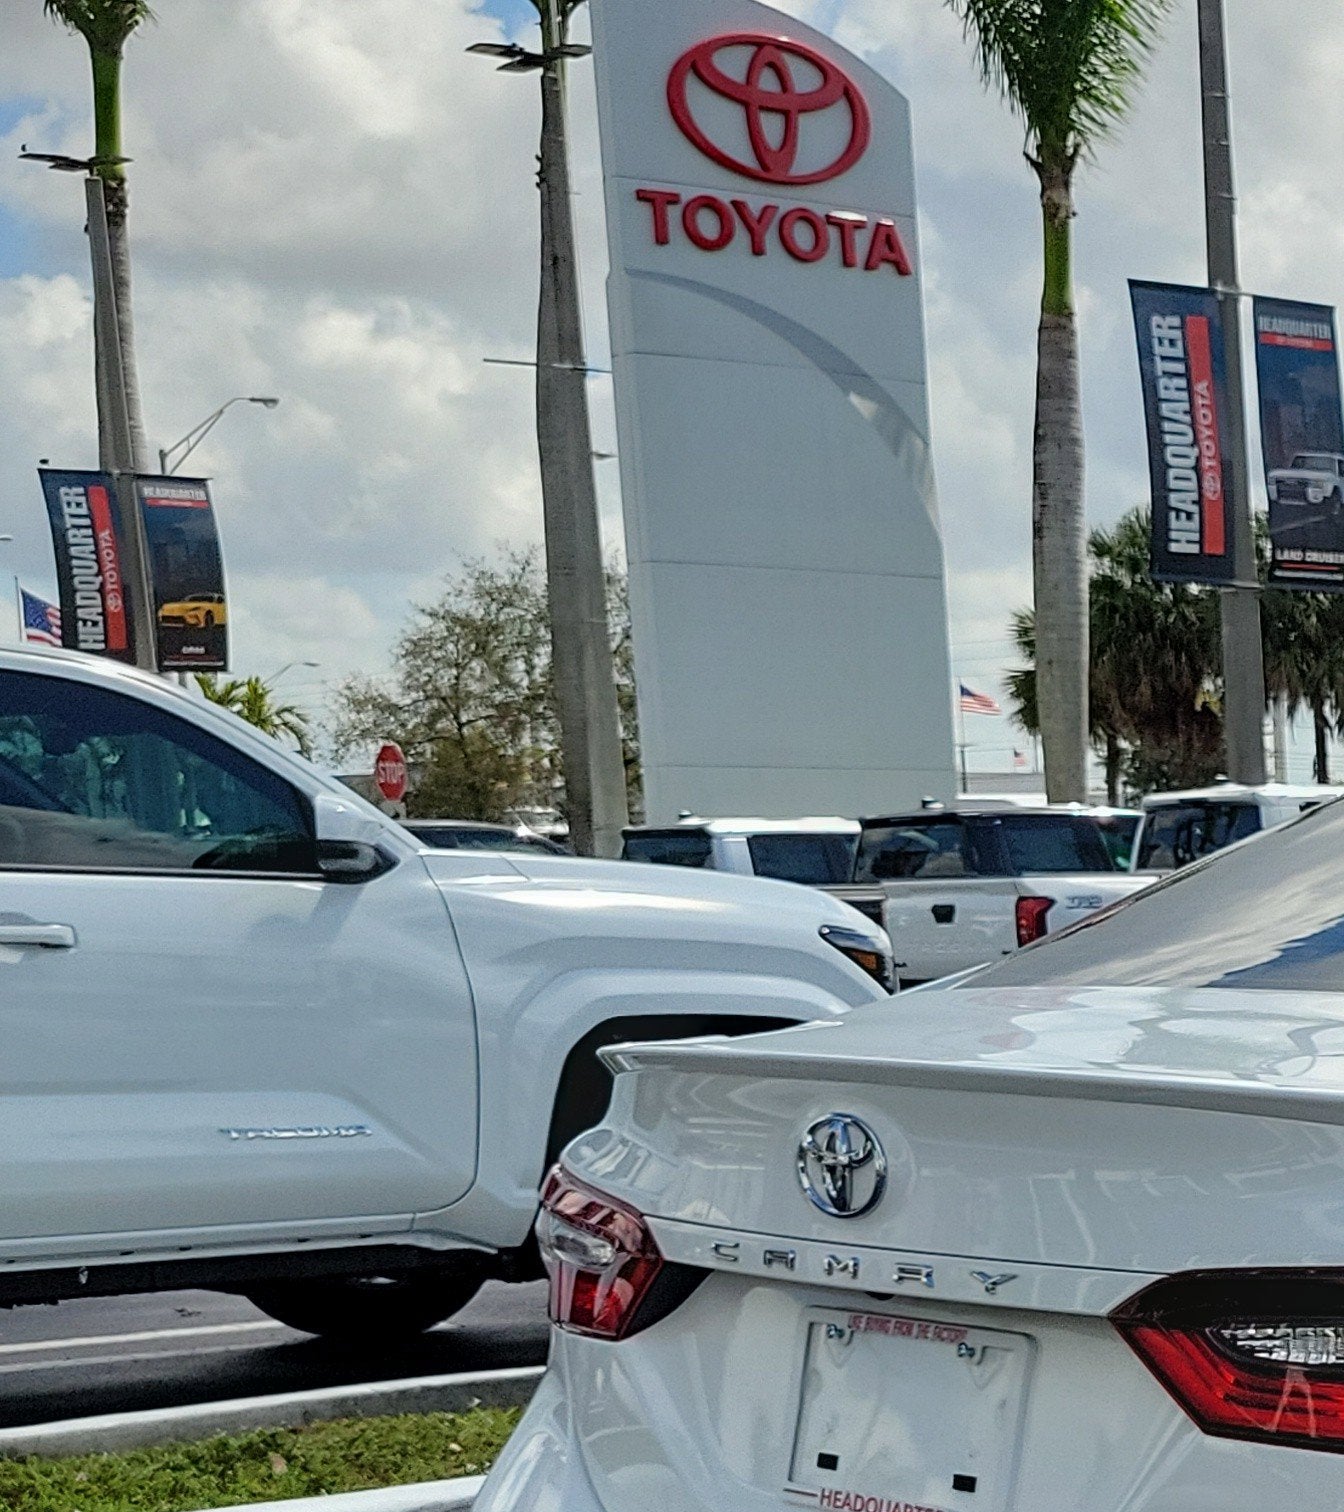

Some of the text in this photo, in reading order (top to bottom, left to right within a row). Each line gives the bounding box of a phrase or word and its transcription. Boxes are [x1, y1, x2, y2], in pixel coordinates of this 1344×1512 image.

[636, 189, 912, 276] TOYOTA
[1151, 314, 1201, 554] HEADQUARTER
[1193, 381, 1221, 471] TOYOTA
[59, 486, 106, 650] HEADQUARTER
[100, 530, 123, 592] TOYOTA
[1275, 548, 1303, 561] LAND
[378, 761, 404, 784] STOP
[710, 1240, 1018, 1294] CAMRY
